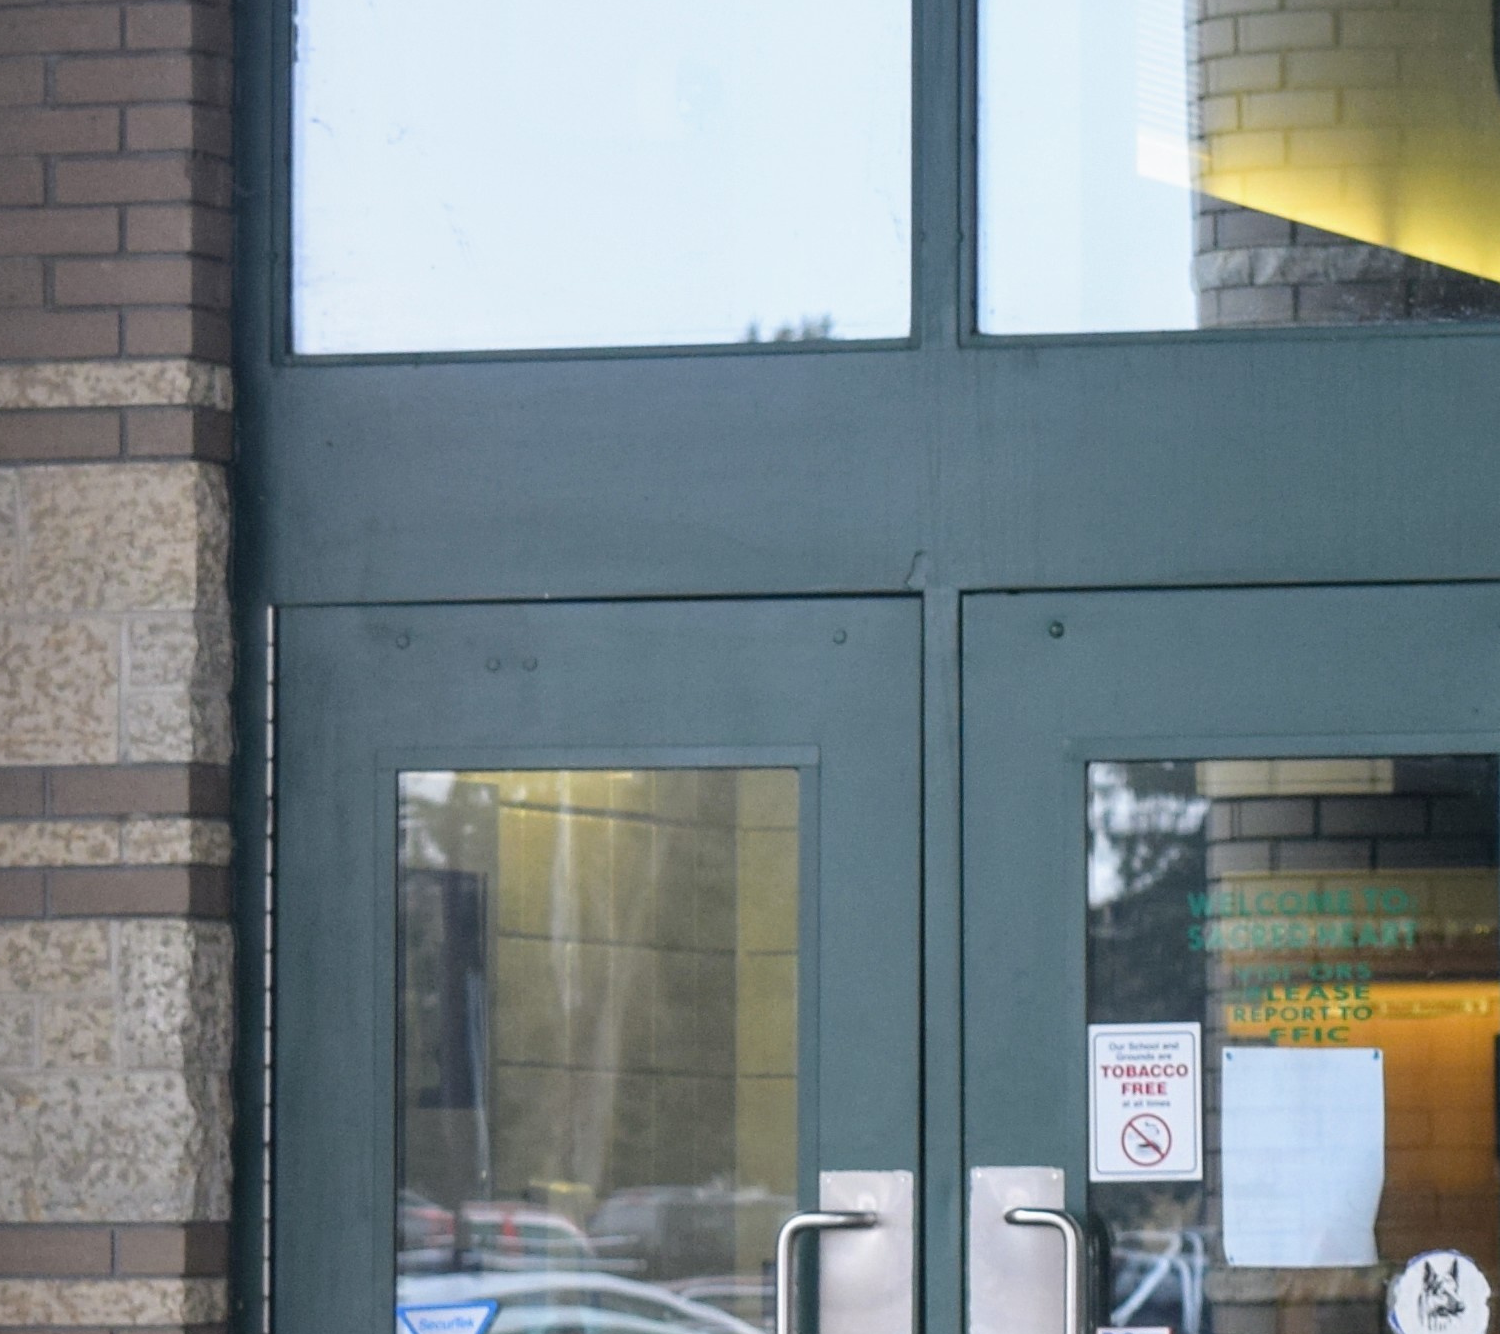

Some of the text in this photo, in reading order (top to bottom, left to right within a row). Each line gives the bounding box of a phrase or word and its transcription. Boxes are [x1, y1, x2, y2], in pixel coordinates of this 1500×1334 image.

[1187, 889, 1353, 917] WELCOME
[1187, 920, 1418, 951] SACRED HEART
[1233, 963, 1372, 981] VISIORS
[1233, 1006, 1373, 1022] REPORT TO
[1269, 1026, 1350, 1043] FFIC
[1101, 1064, 1189, 1078] TOBACCO
[1121, 1082, 1167, 1095] FREE
